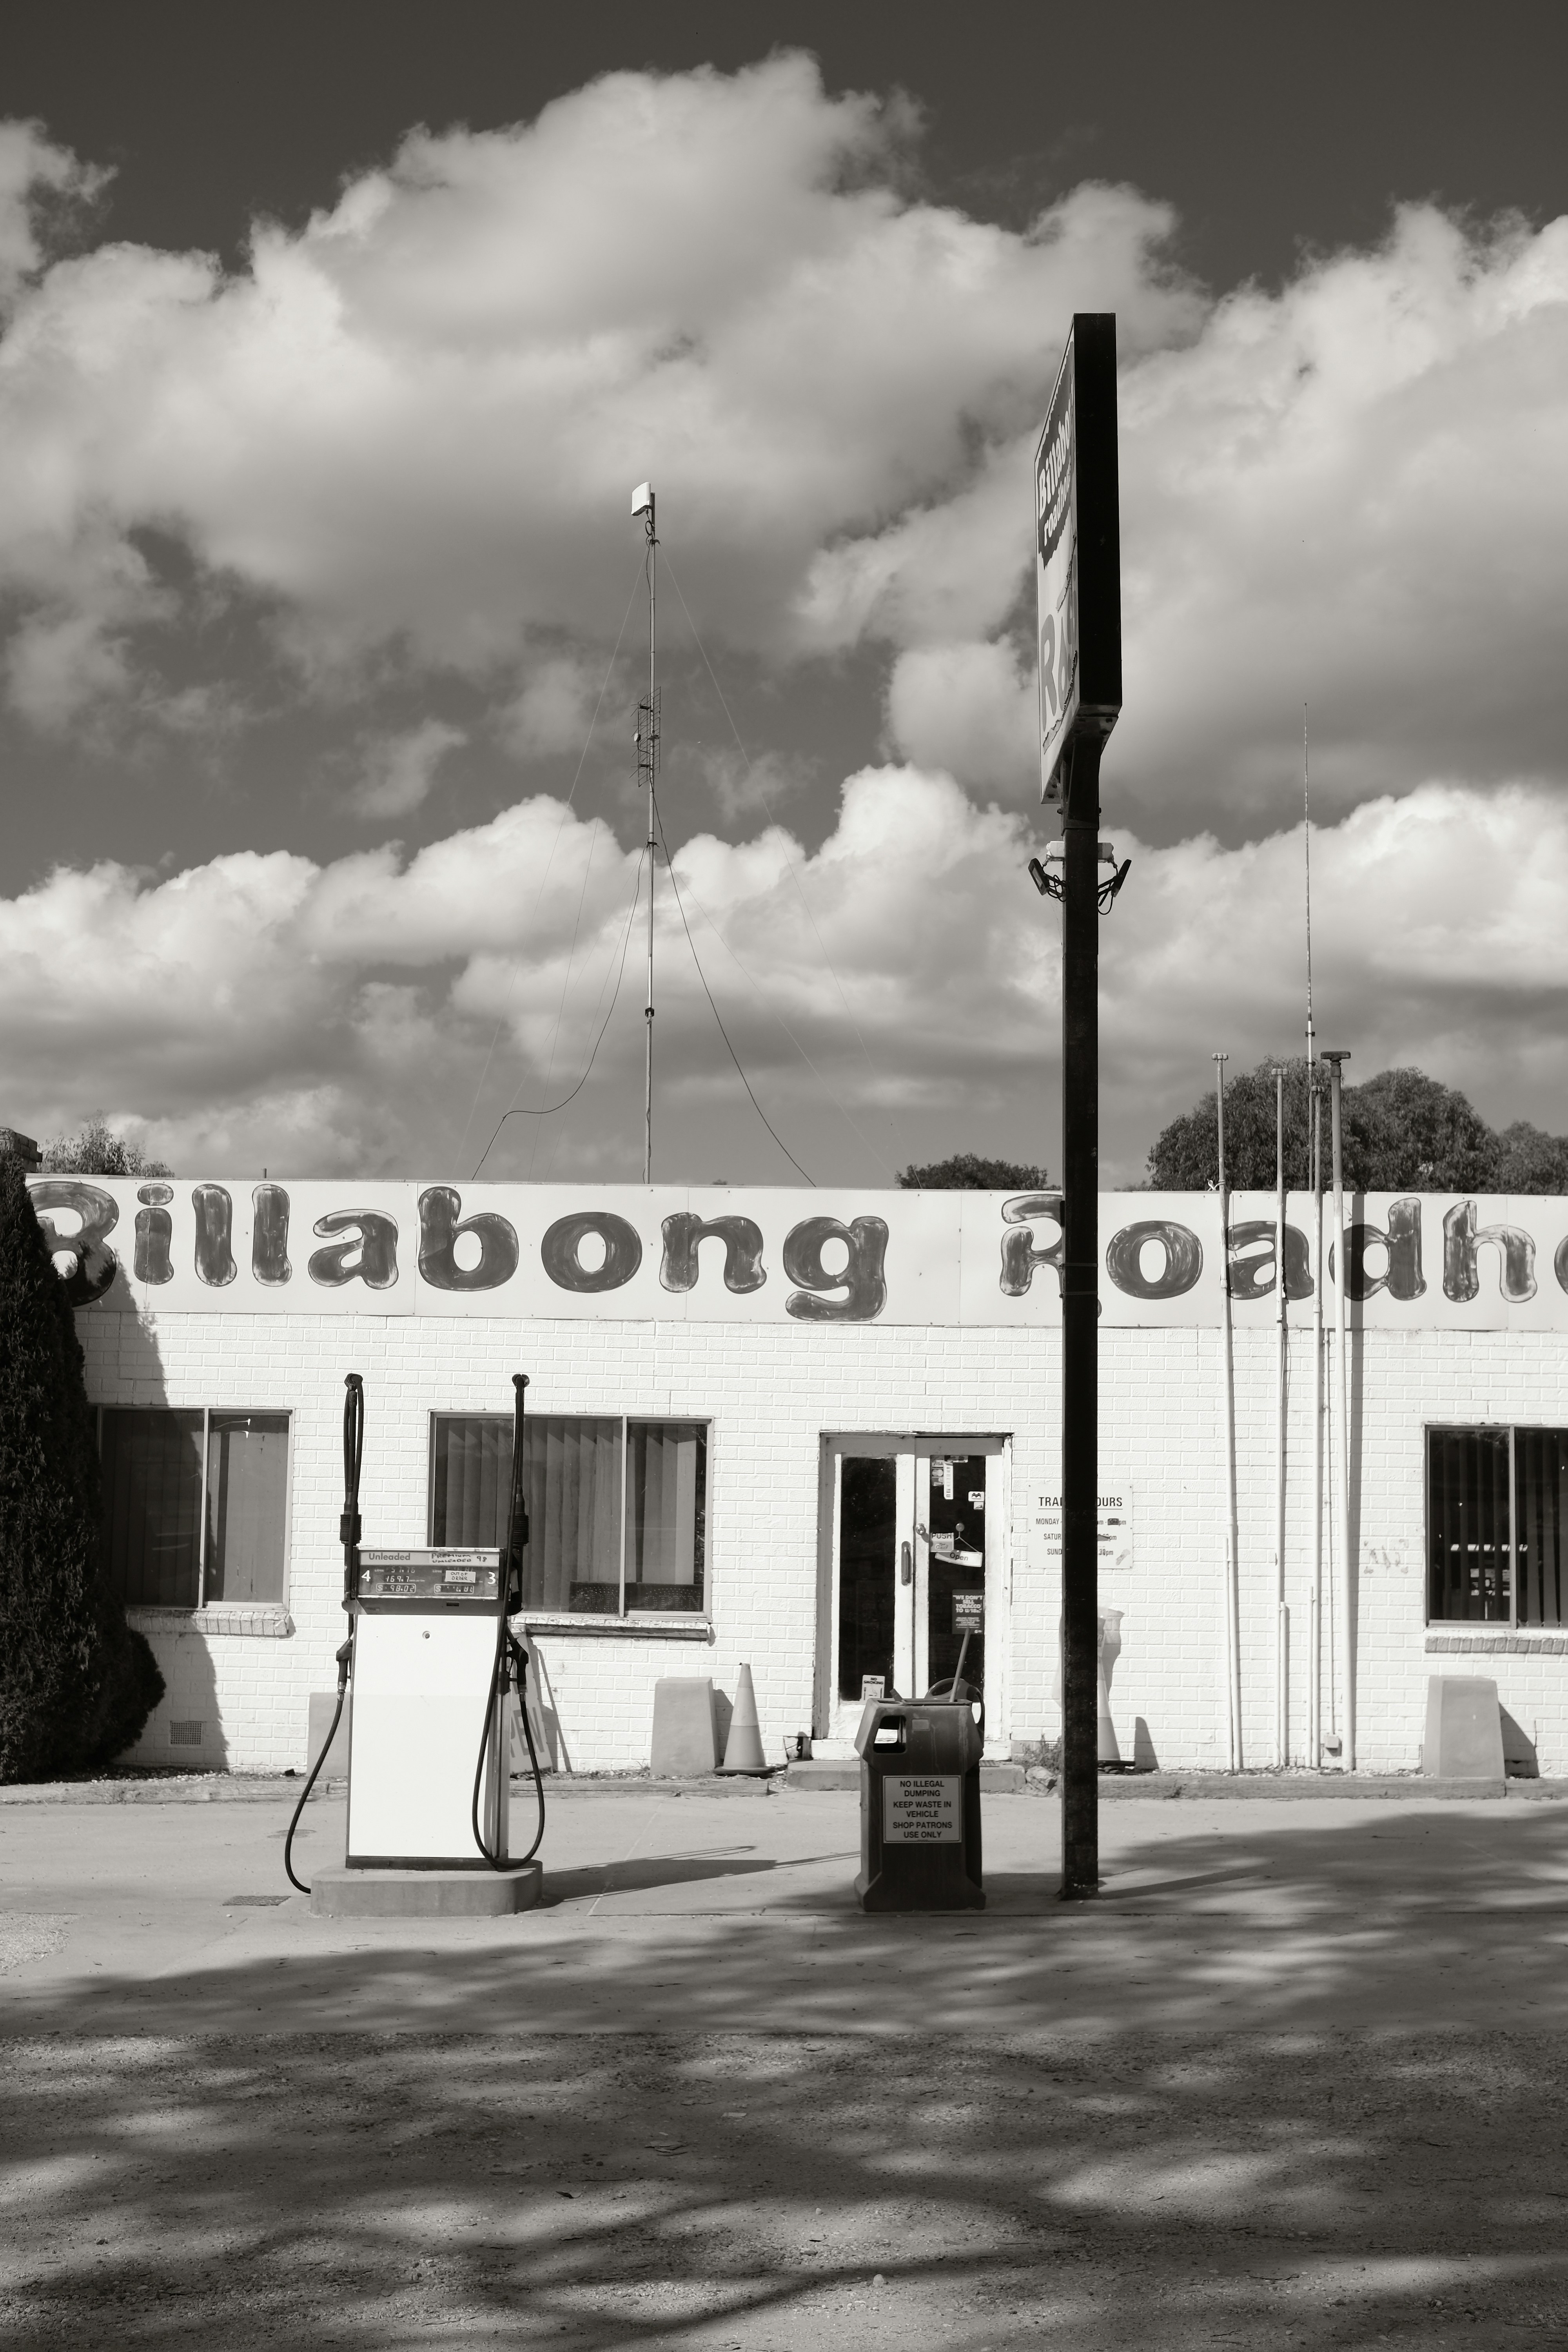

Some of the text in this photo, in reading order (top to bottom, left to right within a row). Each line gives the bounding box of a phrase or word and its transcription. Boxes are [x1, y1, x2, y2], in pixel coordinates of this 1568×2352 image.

[27, 1181, 1568, 1321] Billabong Roadh
[950, 1552, 968, 1561] Open
[361, 1570, 371, 1582] 4
[488, 1572, 496, 1584] 3
